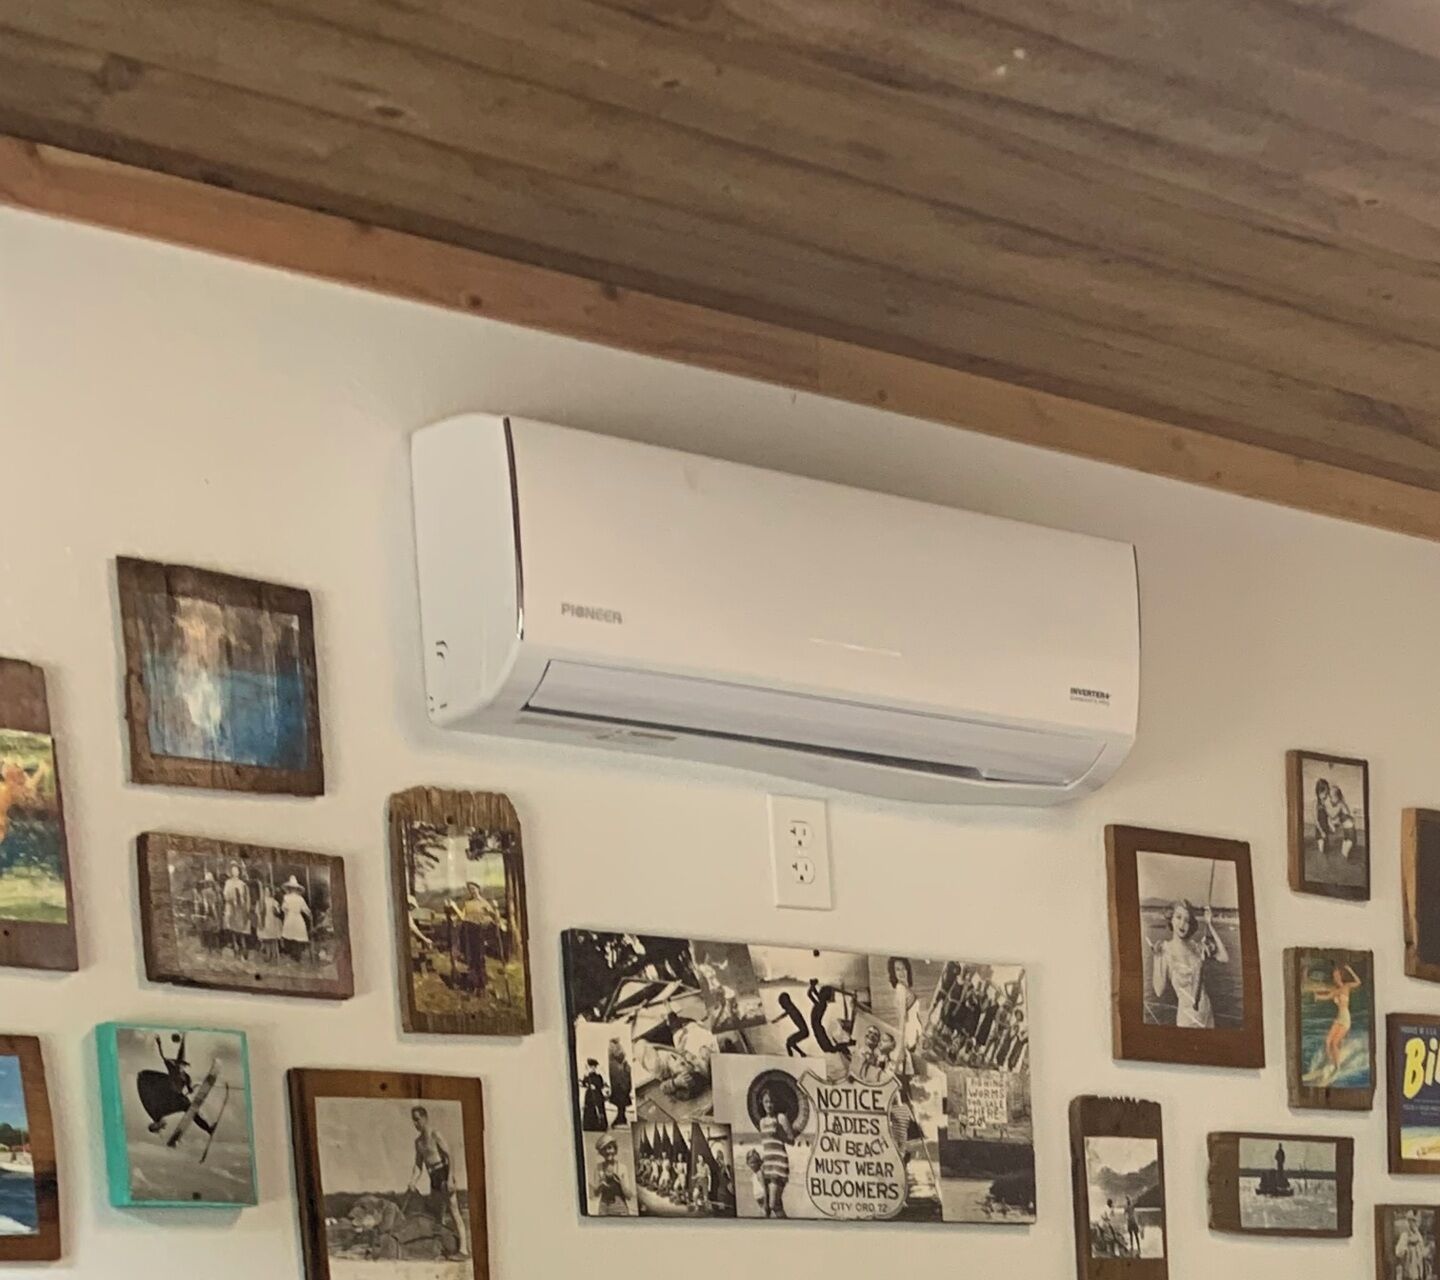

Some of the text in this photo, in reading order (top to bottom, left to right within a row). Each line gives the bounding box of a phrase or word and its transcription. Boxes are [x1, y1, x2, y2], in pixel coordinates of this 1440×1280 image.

[561, 603, 623, 624] PIONEER
[817, 1088, 885, 1111] NOTICE
[968, 1089, 1005, 1099] WORMS
[824, 1112, 880, 1136] LADIES
[820, 1136, 889, 1157] ON BEACH
[815, 1158, 894, 1177] MUST WEAR
[811, 1177, 899, 1200] BLOOMERS
[830, 1201, 852, 1212] CITY
